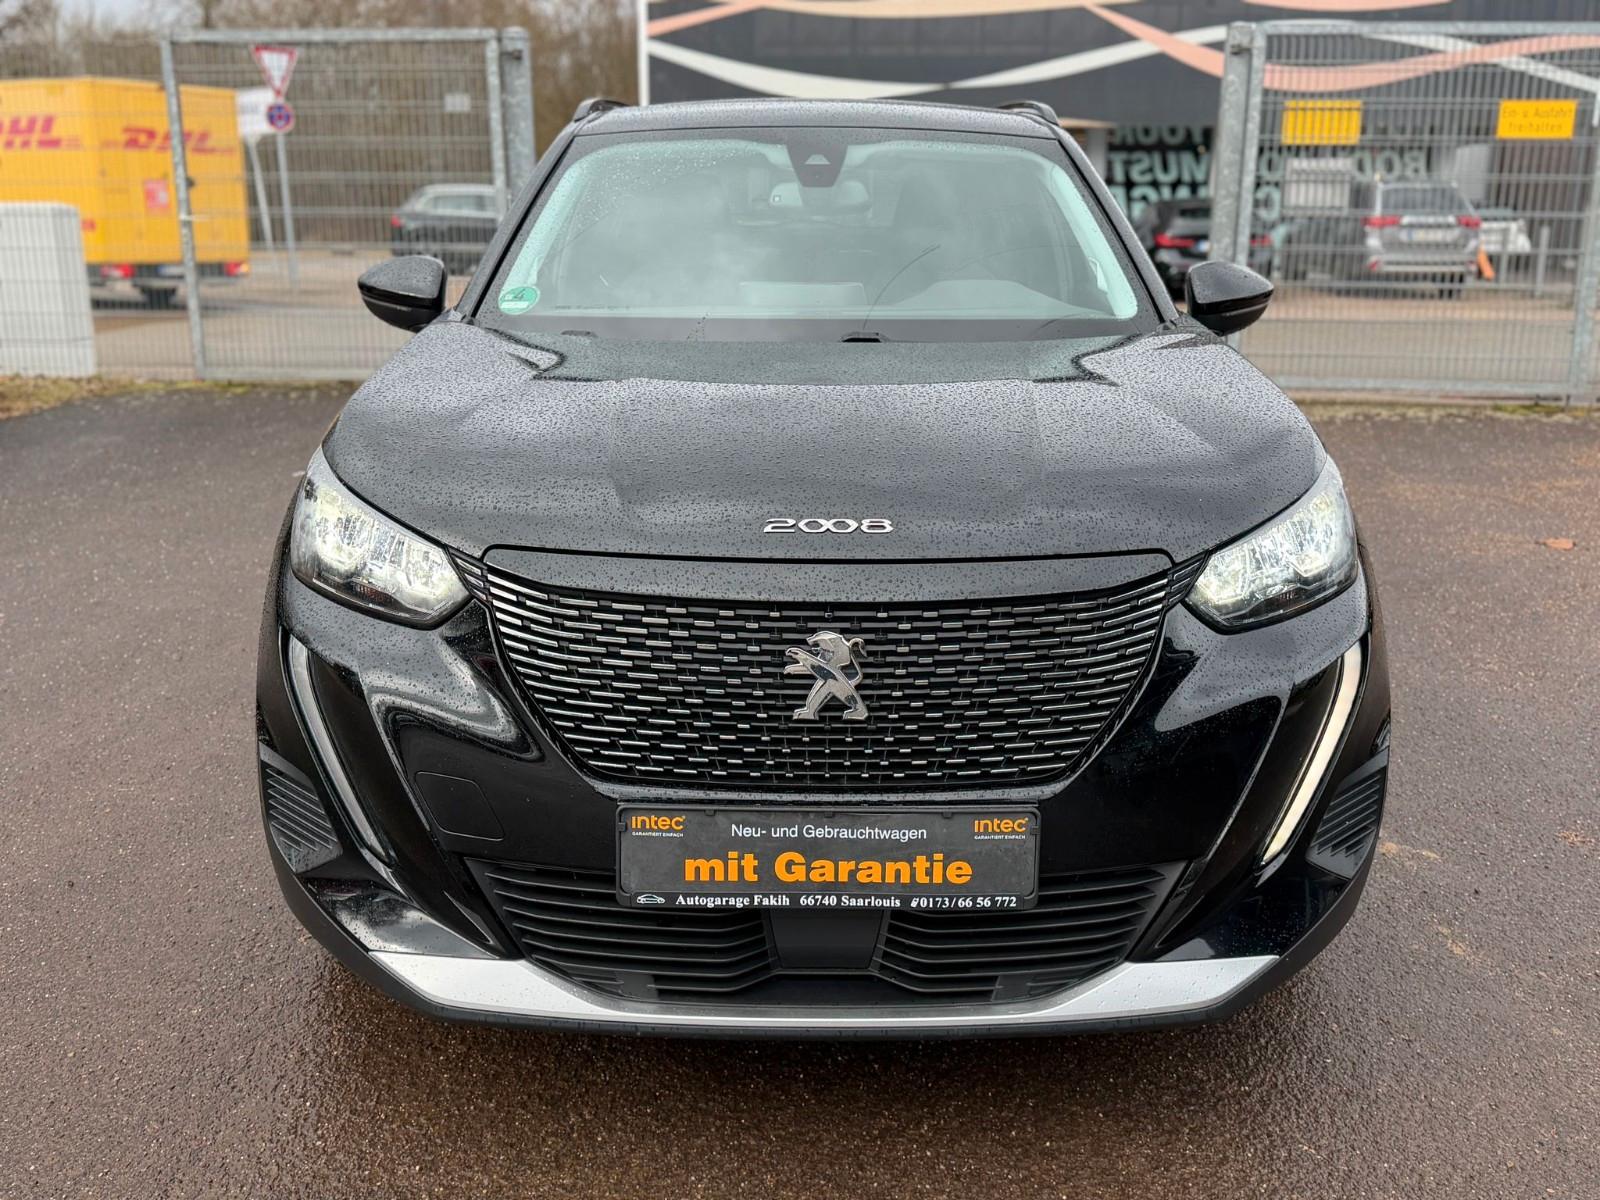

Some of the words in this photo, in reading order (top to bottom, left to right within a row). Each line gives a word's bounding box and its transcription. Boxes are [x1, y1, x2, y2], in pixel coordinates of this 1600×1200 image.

[0, 115, 62, 149] HL
[763, 518, 895, 534] 2008
[631, 815, 684, 830] intec
[974, 818, 1026, 833] intec
[731, 824, 767, 838] Neu-
[771, 824, 798, 838] und
[803, 825, 927, 842] Gebrauchtwagen
[684, 851, 759, 882] mit
[774, 851, 973, 885] Garantie
[675, 894, 751, 909] Autogarage
[753, 894, 790, 906] Fakih
[799, 895, 837, 906] 66740
[841, 896, 901, 907] Saarlouis
[976, 897, 991, 908] 56
[994, 897, 1017, 908] 772
